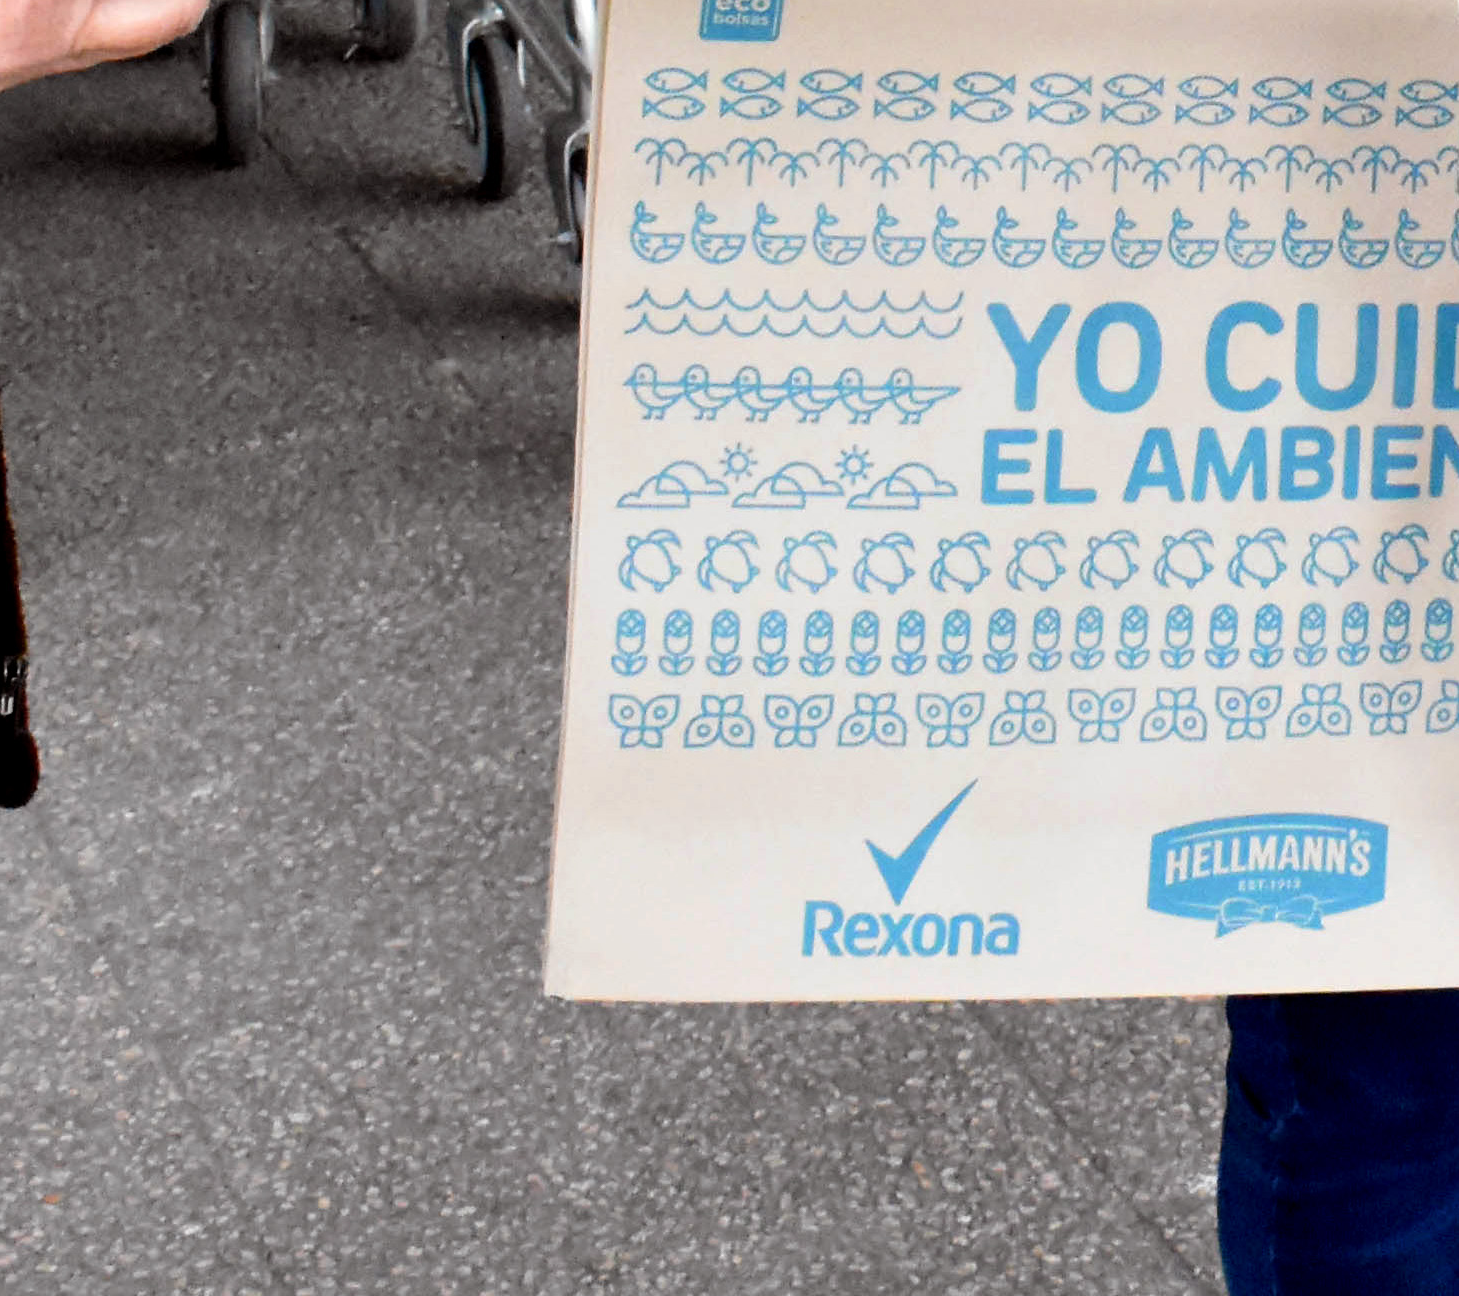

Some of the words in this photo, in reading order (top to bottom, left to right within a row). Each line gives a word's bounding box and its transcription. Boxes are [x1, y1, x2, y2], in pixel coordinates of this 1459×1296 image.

[987, 302, 1162, 414] YO
[981, 428, 1097, 506] EL
[1164, 828, 1372, 887] HELLMANN'S
[802, 901, 1020, 957] Rexona
